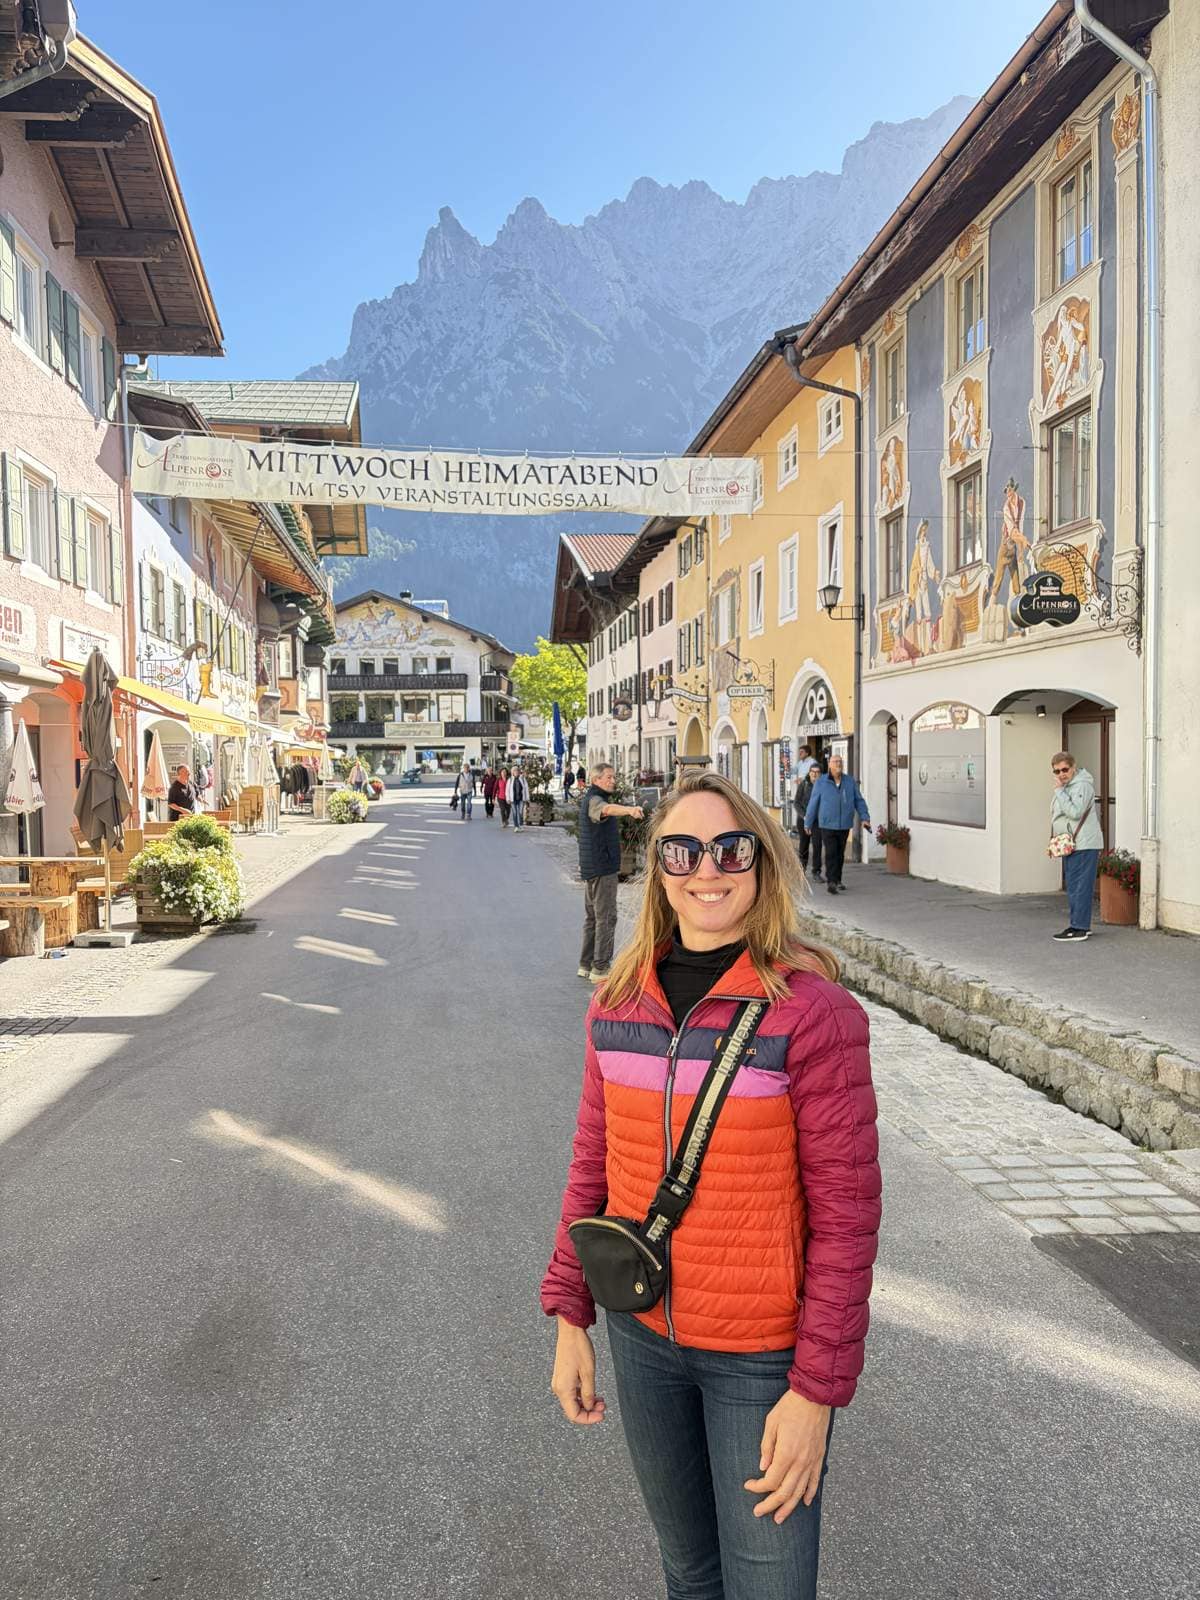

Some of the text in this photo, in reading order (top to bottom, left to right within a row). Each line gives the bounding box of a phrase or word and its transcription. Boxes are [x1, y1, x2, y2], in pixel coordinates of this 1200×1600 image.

[137, 443, 233, 479] ALPENROSE
[247, 448, 658, 488] MITTWOCH HEIMATABEND
[289, 481, 613, 507] IM TSV VERANSTALTUNGSSAAL
[715, 1003, 762, 1077] lululemo
